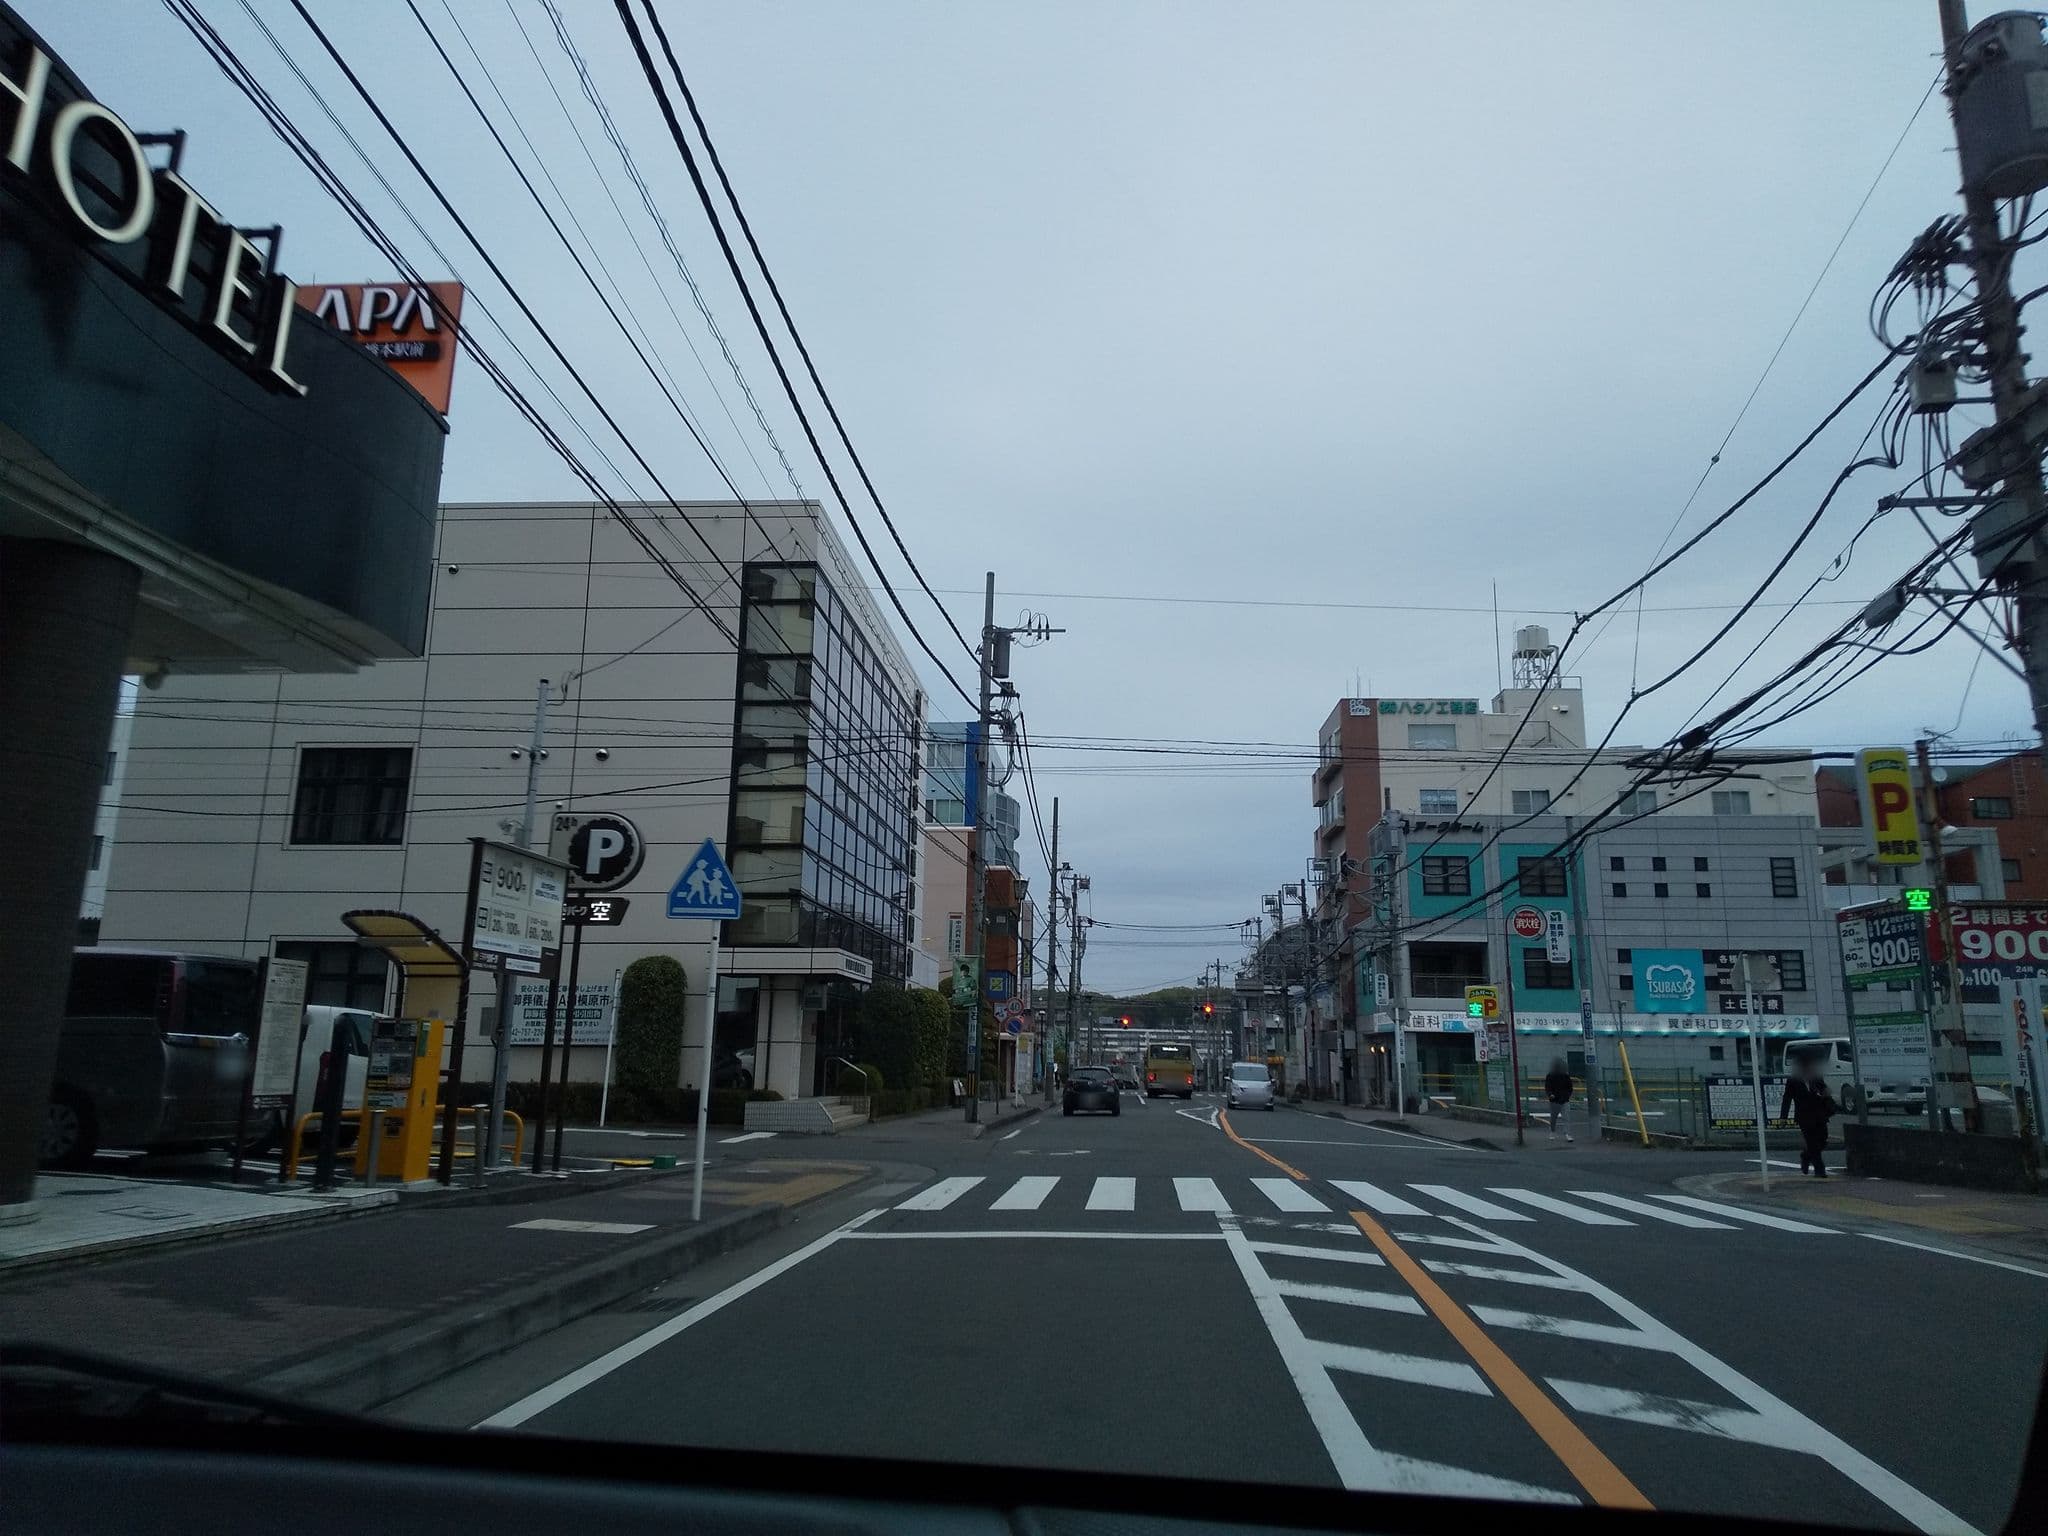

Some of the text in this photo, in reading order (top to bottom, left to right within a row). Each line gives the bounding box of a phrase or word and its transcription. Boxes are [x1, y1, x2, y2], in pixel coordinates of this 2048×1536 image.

[314, 287, 437, 332] APA
[1872, 782, 1909, 832] P
[585, 829, 624, 874] P
[590, 901, 611, 921] 空
[1516, 918, 1541, 929] 消火栓
[1960, 929, 2048, 960] 900
[1648, 981, 1690, 994] TSUBASA
[1483, 998, 1497, 1016] P
[1794, 1017, 1812, 1030] 2F
